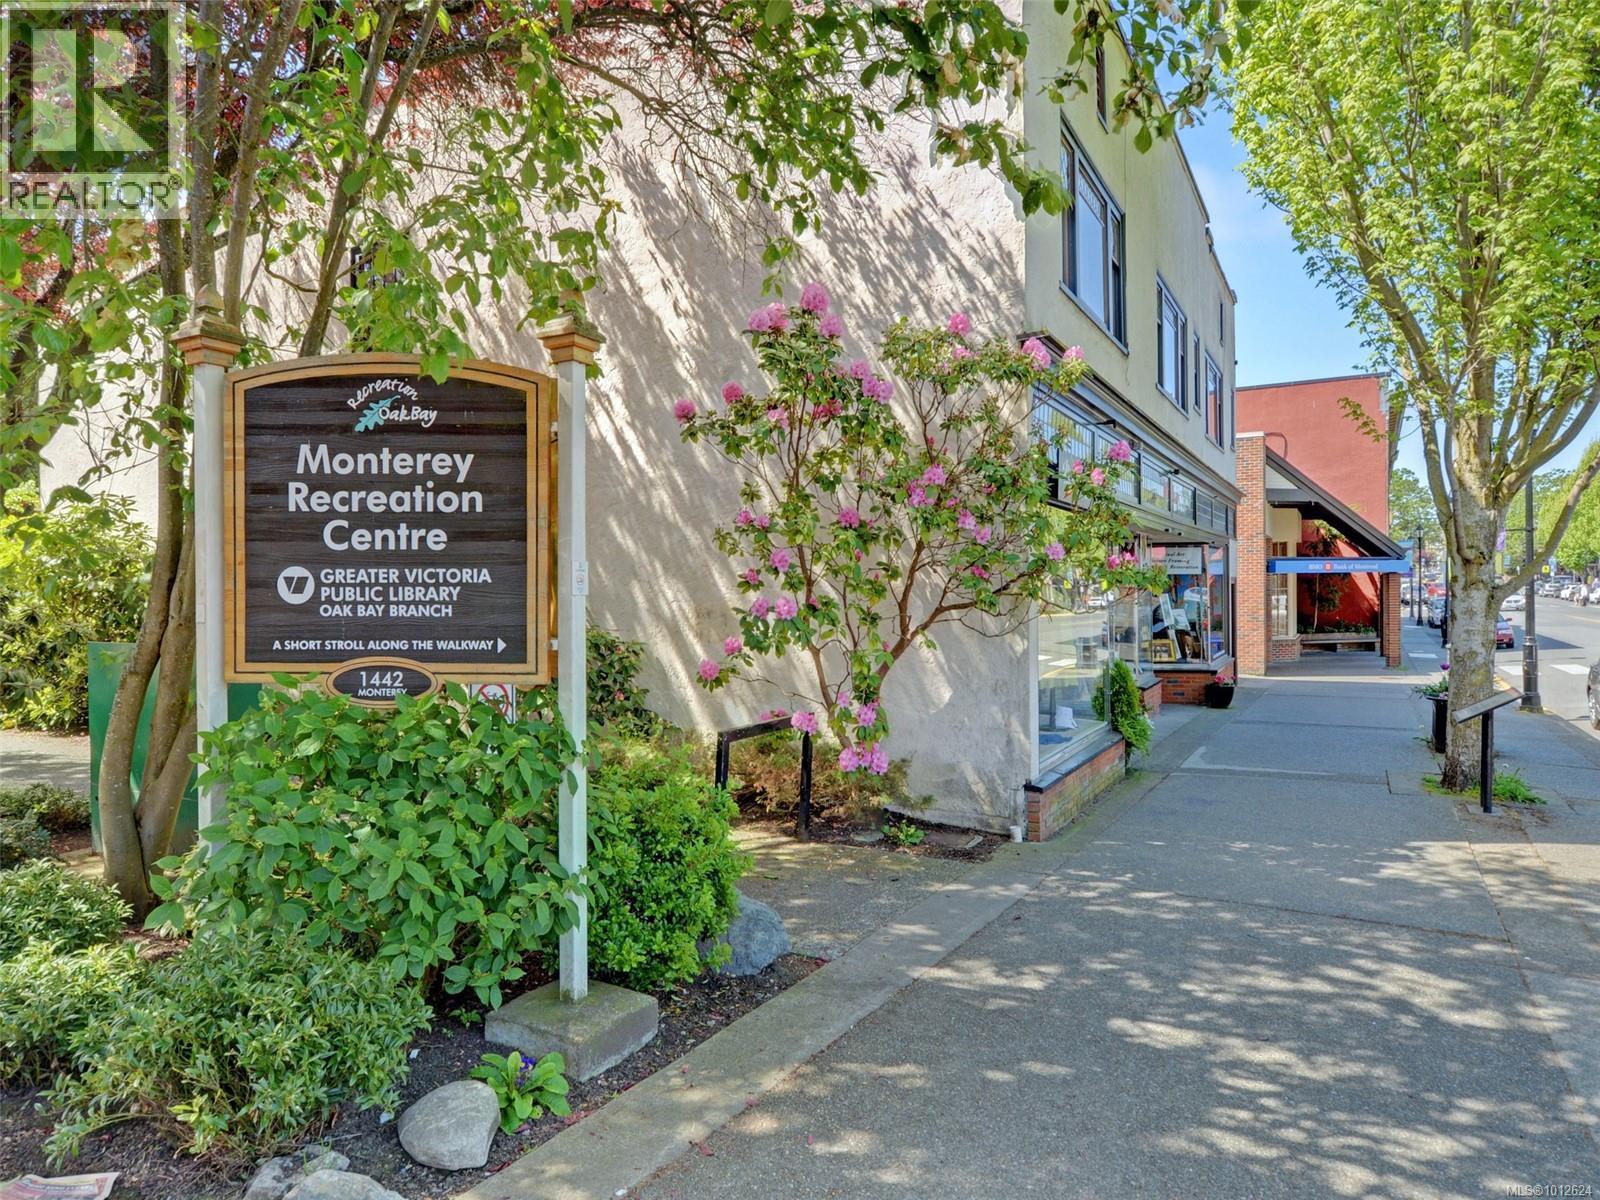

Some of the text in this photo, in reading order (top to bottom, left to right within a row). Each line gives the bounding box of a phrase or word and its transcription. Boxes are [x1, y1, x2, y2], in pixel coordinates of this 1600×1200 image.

[347, 378, 418, 410] Recreation
[296, 443, 475, 483] Monterey
[288, 480, 483, 513] Recreation
[322, 519, 448, 550] Centre
[320, 568, 492, 584] GREATER VICTORIA
[320, 586, 461, 602] PUBLIC LIBRARY
[319, 604, 453, 617] OAK BAY BRANCH
[272, 640, 494, 650] A SHORT STROLL ALONG THE WALKWAY
[360, 671, 404, 687] 1442
